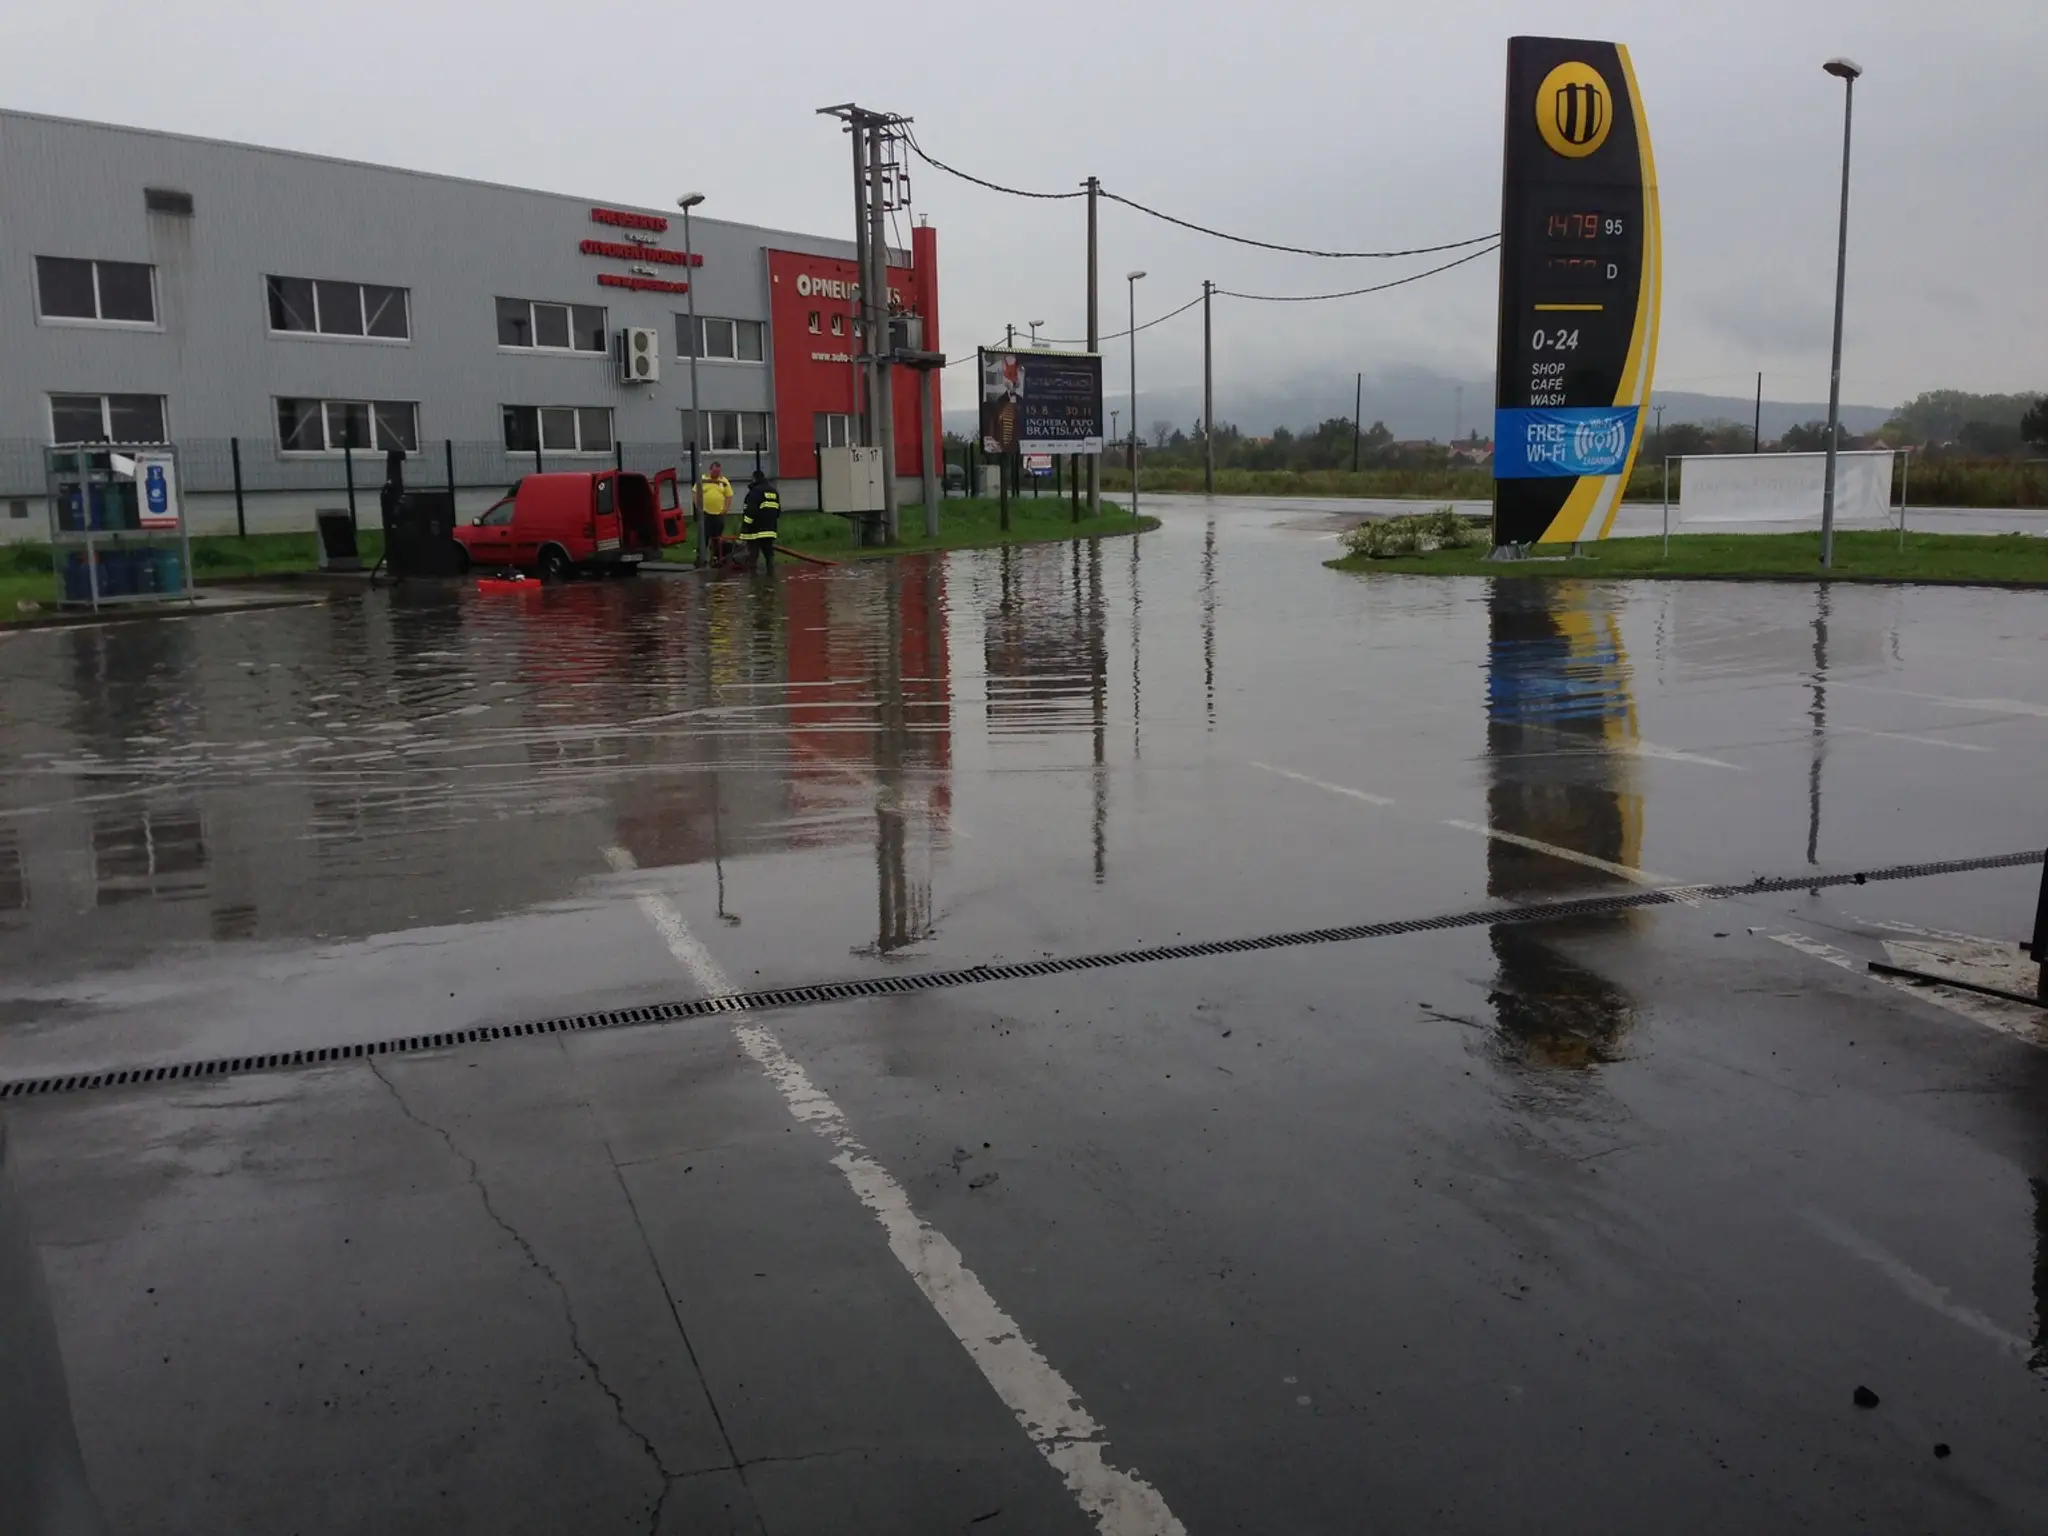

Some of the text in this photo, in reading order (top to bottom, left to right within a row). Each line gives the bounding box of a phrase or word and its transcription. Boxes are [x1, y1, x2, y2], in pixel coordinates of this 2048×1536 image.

[1548, 214, 1623, 238] 1479 95
[1606, 263, 1618, 279] D
[1532, 328, 1580, 351] 0-24
[1531, 362, 1566, 375] SHOP
[1530, 376, 1564, 391] CAFÉ
[1530, 394, 1567, 406] WASH
[1026, 418, 1094, 427] INCHEBA EXPO
[1026, 426, 1094, 436] BRATISLAVA
[1527, 423, 1565, 442] FREE
[1527, 443, 1566, 463] Wi-Fi
